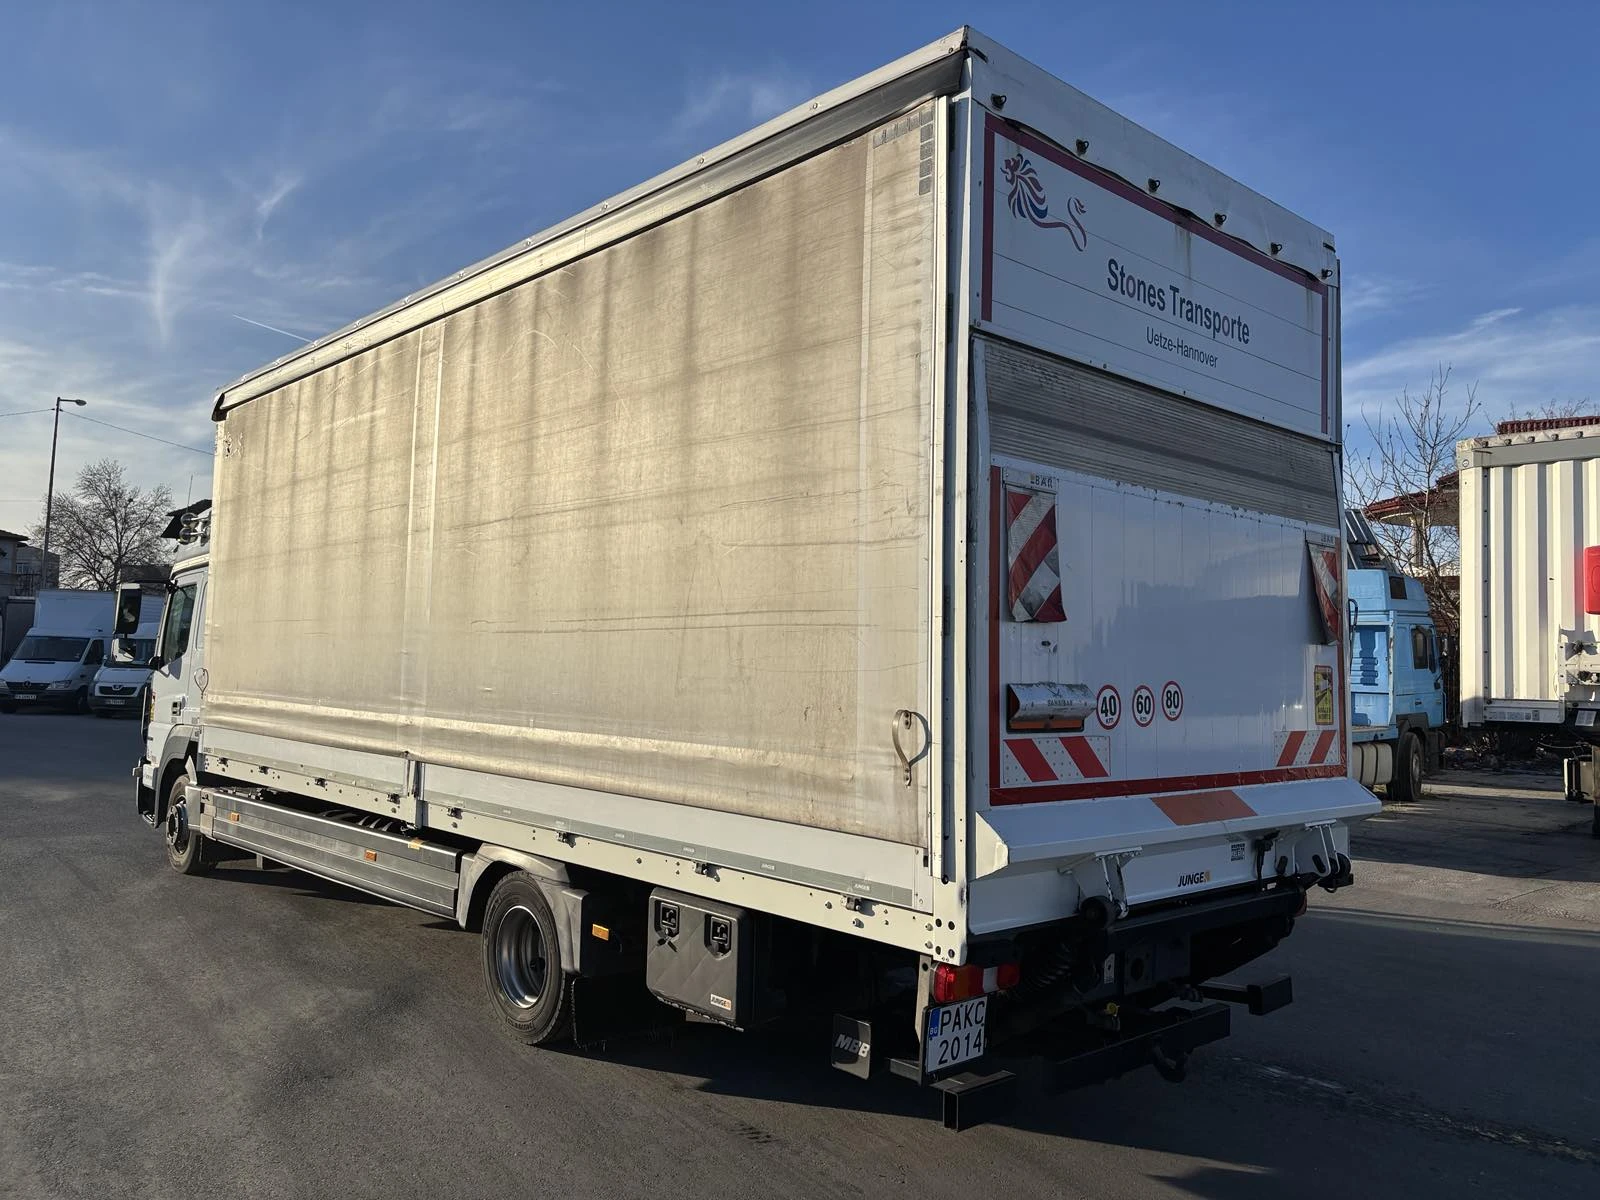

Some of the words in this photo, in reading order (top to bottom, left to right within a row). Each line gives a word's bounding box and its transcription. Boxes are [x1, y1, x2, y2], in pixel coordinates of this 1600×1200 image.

[1107, 258, 1166, 312] Stones
[1169, 284, 1250, 344] Transporte
[1146, 326, 1218, 368] Uetze-Hannover
[1101, 695, 1117, 717] 40
[1136, 694, 1152, 715] 60
[1165, 689, 1180, 709] 80
[1178, 871, 1205, 888] JUNGE
[940, 1000, 986, 1036] PAKC
[929, 1026, 938, 1036] BG
[835, 1033, 871, 1058] MBB
[938, 1028, 982, 1065] 2014
